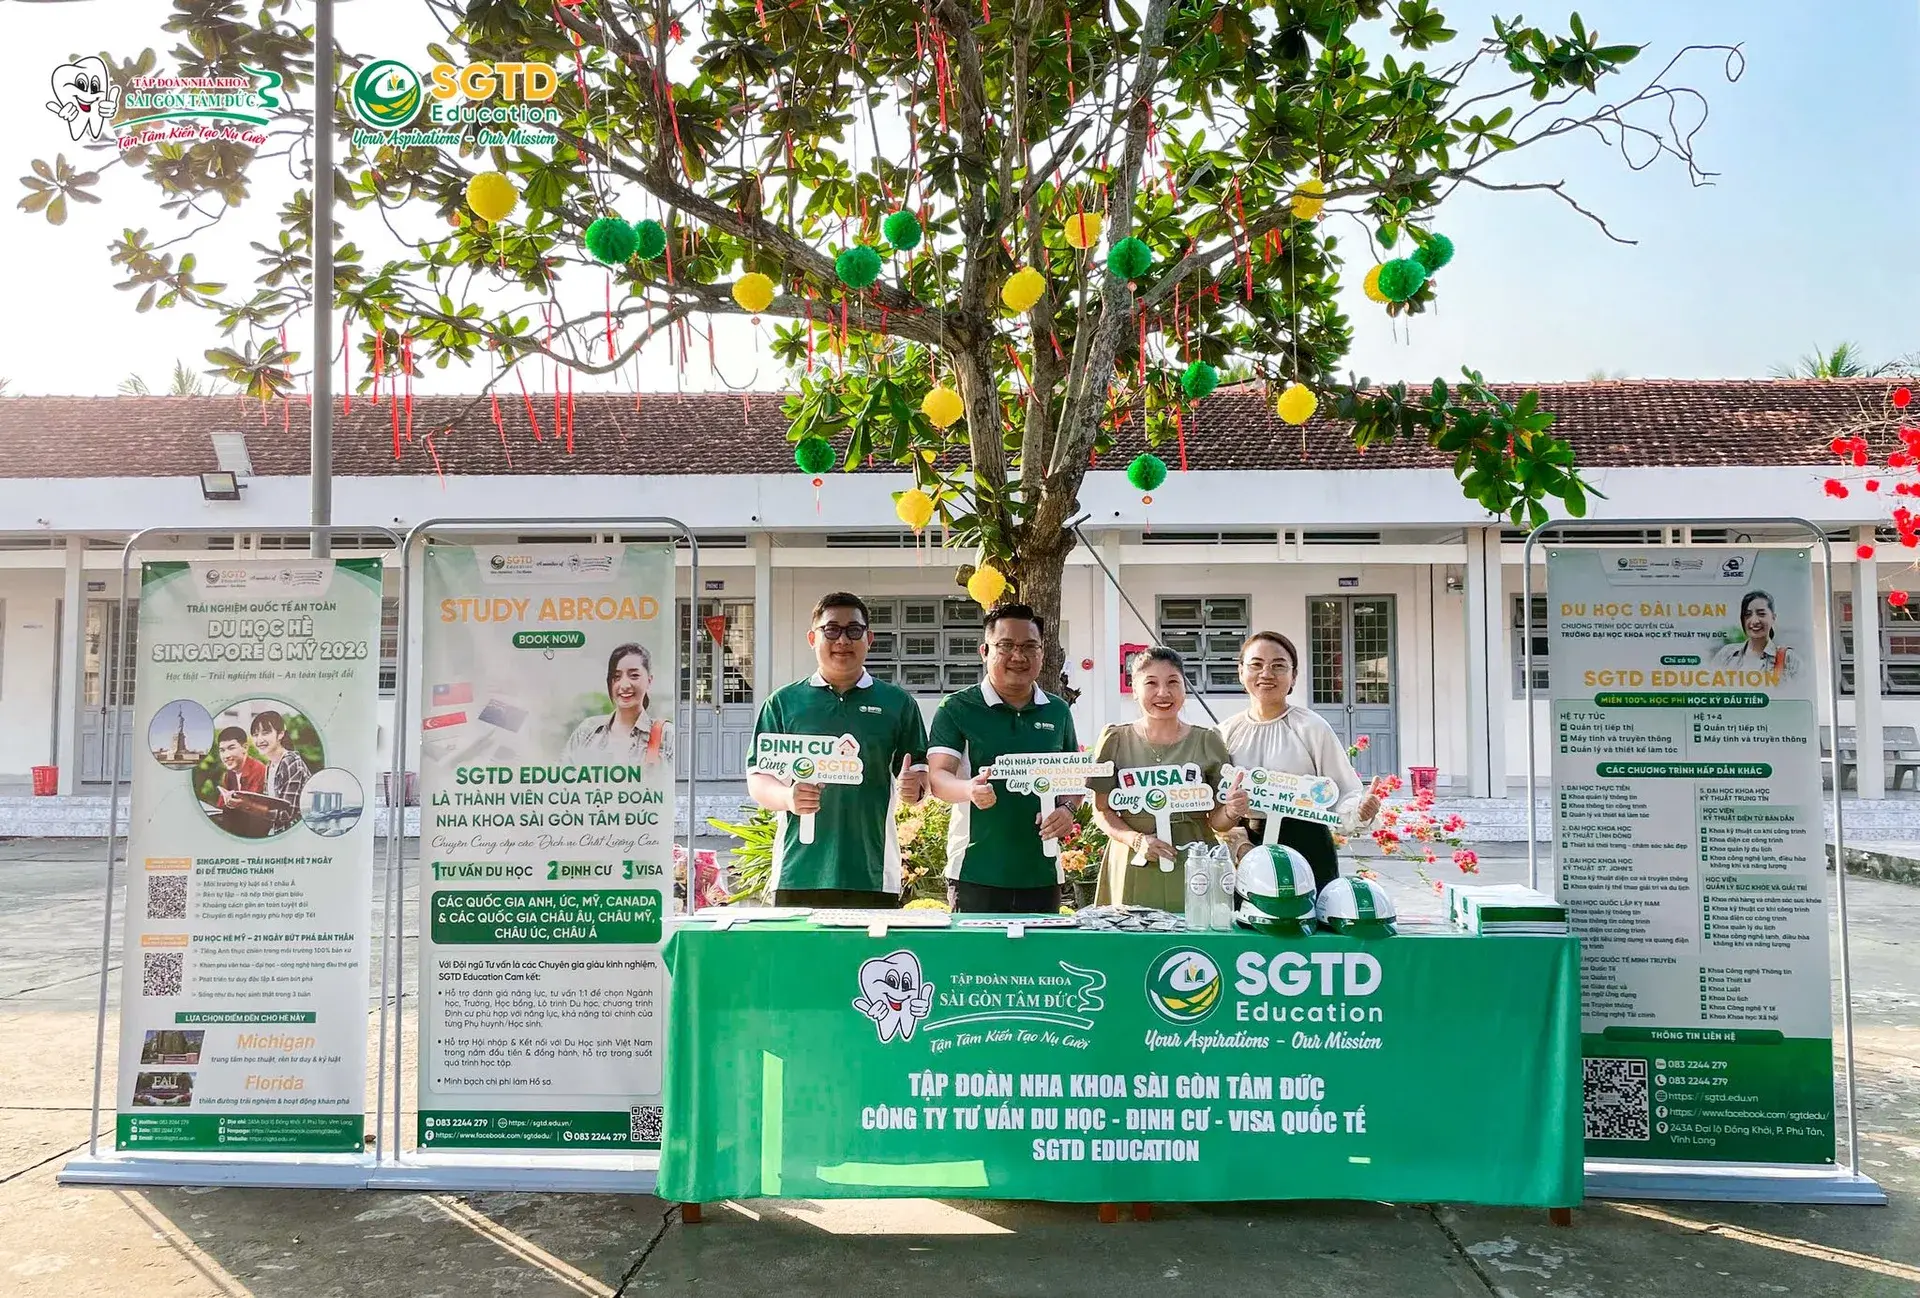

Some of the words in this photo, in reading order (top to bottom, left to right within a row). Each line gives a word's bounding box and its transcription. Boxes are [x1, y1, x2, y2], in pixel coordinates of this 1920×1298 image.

[250, 601, 277, 613] QUỐC
[281, 600, 293, 611] TẾ
[294, 603, 307, 612] AN
[310, 601, 336, 611] TOÀN
[440, 599, 531, 622] STUDY
[539, 596, 660, 621] ABROAD
[1593, 604, 1633, 620] HỌC
[1640, 601, 1670, 616] ĐÀI
[1678, 604, 1726, 616] LOAN
[208, 620, 237, 638] DU
[240, 619, 284, 642] HỌC
[288, 615, 313, 637] HÈ
[519, 634, 549, 645] BOOK
[552, 634, 579, 644] NOW
[152, 643, 265, 662] SINGAPORE
[268, 643, 283, 660] &
[287, 638, 318, 660] MỸ
[321, 642, 368, 660] 2026
[1584, 670, 1644, 687] SGTD
[1652, 670, 1780, 687] EDUCATION
[760, 739, 803, 756] ĐỊNH
[807, 741, 835, 755] CƯ
[456, 767, 513, 784] SGTD
[520, 765, 641, 784] EDUCATION
[760, 757, 787, 775] Cùng
[818, 760, 859, 772] SGTD
[1135, 769, 1183, 787] VISA
[432, 790, 450, 806] LÀ
[455, 790, 505, 805] THÀNH
[511, 789, 543, 805] VIÊN
[548, 788, 580, 804] CỦA
[585, 788, 613, 808] TẬP
[618, 788, 663, 804] ĐOÀN
[1113, 793, 1142, 809] Cùng
[1170, 785, 1209, 801] SGTD
[1253, 786, 1267, 797] ÚC
[1279, 792, 1295, 802] MỸ
[1170, 801, 1211, 809] Education
[1272, 803, 1296, 815] NEW
[436, 814, 468, 827] NHA
[472, 814, 515, 827] KHOA
[520, 809, 544, 826] SÀI
[548, 809, 584, 826] GÒN
[588, 809, 620, 826] TÂM
[624, 808, 659, 825] ĐỨC
[441, 866, 456, 877] TƯ
[458, 862, 483, 877] VẤN
[486, 866, 501, 876] DU
[505, 866, 533, 880] HỌC
[561, 865, 591, 879] ĐỊNH
[594, 865, 613, 876] CƯ
[636, 865, 663, 876] VISA
[437, 893, 463, 907] CÁC
[465, 893, 502, 908] QUỐC
[504, 897, 526, 907] GIA
[528, 897, 556, 909] ANH,
[559, 894, 579, 909] ÚC,
[582, 893, 603, 909] MỸ,
[605, 896, 656, 907] CANADA
[438, 914, 446, 923] &
[449, 909, 475, 923] CÁC
[477, 908, 513, 924] QUỐC
[516, 913, 538, 923] GIA
[540, 910, 574, 923] CHÂU
[576, 910, 595, 924] ÂU,
[598, 910, 631, 923] CHÂU
[634, 908, 655, 924] MỸ,
[494, 926, 528, 938] CHÂU
[530, 925, 550, 940] ÚC,
[553, 925, 587, 938] CHÂU
[589, 925, 597, 938] Á
[950, 973, 973, 986] TẬP
[976, 972, 1008, 985] ĐOÀN
[1010, 975, 1035, 985] NHA
[1038, 975, 1072, 985] KHOA
[1234, 951, 1382, 996] SGTD
[939, 990, 965, 1006] SÀI
[969, 990, 1003, 1006] GÒN
[1006, 991, 1040, 1008] TÂM
[1044, 989, 1077, 1008] ĐỨC
[1236, 1001, 1383, 1022] Education
[237, 1033, 316, 1052] Michigan
[931, 1038, 952, 1053] Tận
[956, 1032, 982, 1046] Tâm
[985, 1028, 1013, 1043] Kiến
[1017, 1029, 1038, 1043] Tạo
[1040, 1031, 1060, 1047] Nụ
[1062, 1033, 1091, 1050] Cười
[1144, 1029, 1181, 1050] Your
[1184, 1029, 1270, 1053] Aspirations
[1291, 1030, 1322, 1049] Our
[1324, 1031, 1383, 1050] Mission
[1651, 1030, 1683, 1040] THÔNG
[1686, 1032, 1700, 1040] TIN
[1703, 1030, 1721, 1041] LIÊN
[1724, 1031, 1736, 1042] HỆ
[1668, 1060, 1685, 1069] 083
[1688, 1060, 1709, 1070] 2244
[1712, 1061, 1727, 1070] 279
[154, 1076, 177, 1086] FAU
[245, 1075, 304, 1090] Florida
[908, 1069, 949, 1102] TẬP
[955, 1069, 1013, 1097] ĐOÀN
[1020, 1075, 1063, 1097] NHA
[1070, 1075, 1127, 1098] KHOA
[1133, 1071, 1168, 1099] SÀI
[1176, 1073, 1220, 1099] GÒN
[1227, 1073, 1272, 1100] TÂM
[1280, 1074, 1325, 1100] ĐỨC
[435, 1119, 451, 1127] 083
[452, 1119, 472, 1127] 2244
[474, 1119, 488, 1127] 279
[862, 1104, 918, 1130] CÔNG
[923, 1108, 948, 1130] TY
[953, 1105, 980, 1130] TƯ
[985, 1101, 1025, 1130] VẤN
[1031, 1108, 1058, 1130] DU
[1064, 1108, 1106, 1134] HỌC
[1126, 1109, 1174, 1134] ĐỊNH
[1181, 1107, 1212, 1131] CƯ
[1229, 1110, 1275, 1132] VISA
[1281, 1104, 1337, 1134] QUỐC
[1343, 1104, 1367, 1133] TẾ
[1032, 1139, 1085, 1161] SGTD
[1091, 1140, 1199, 1162] EDUCATION
